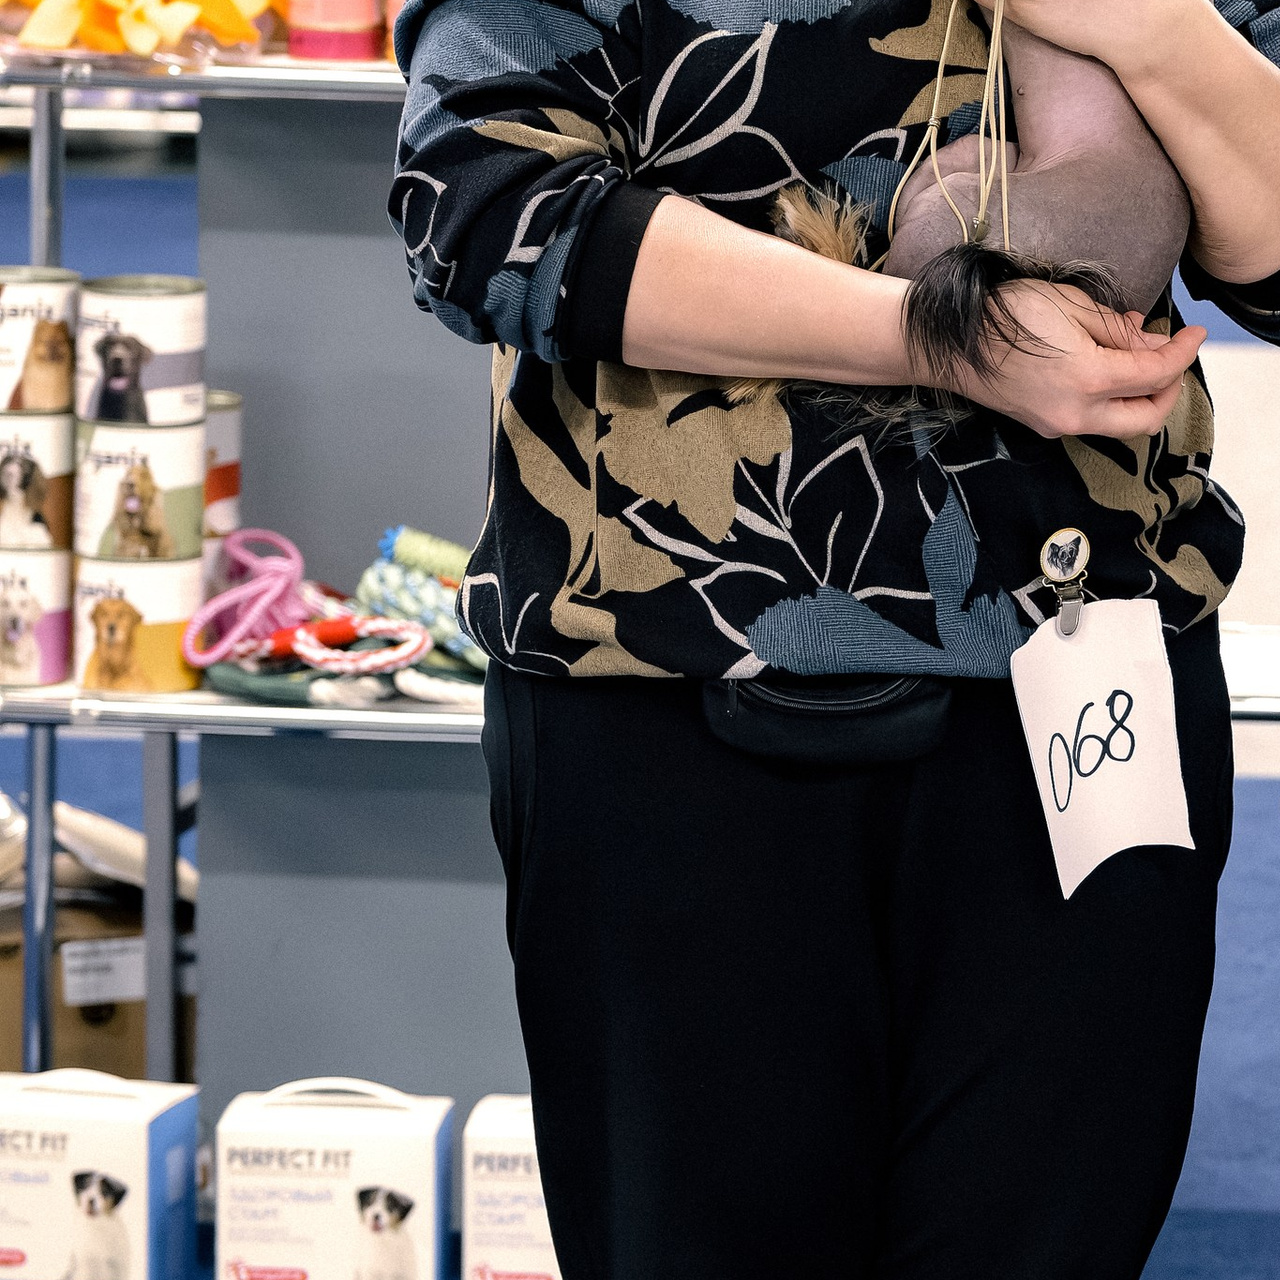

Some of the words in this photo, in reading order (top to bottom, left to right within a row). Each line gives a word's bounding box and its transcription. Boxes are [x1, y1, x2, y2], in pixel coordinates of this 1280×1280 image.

[1048, 689, 1136, 813] 068
[227, 1147, 315, 1169] PERFECT
[321, 1150, 353, 1169] FIT
